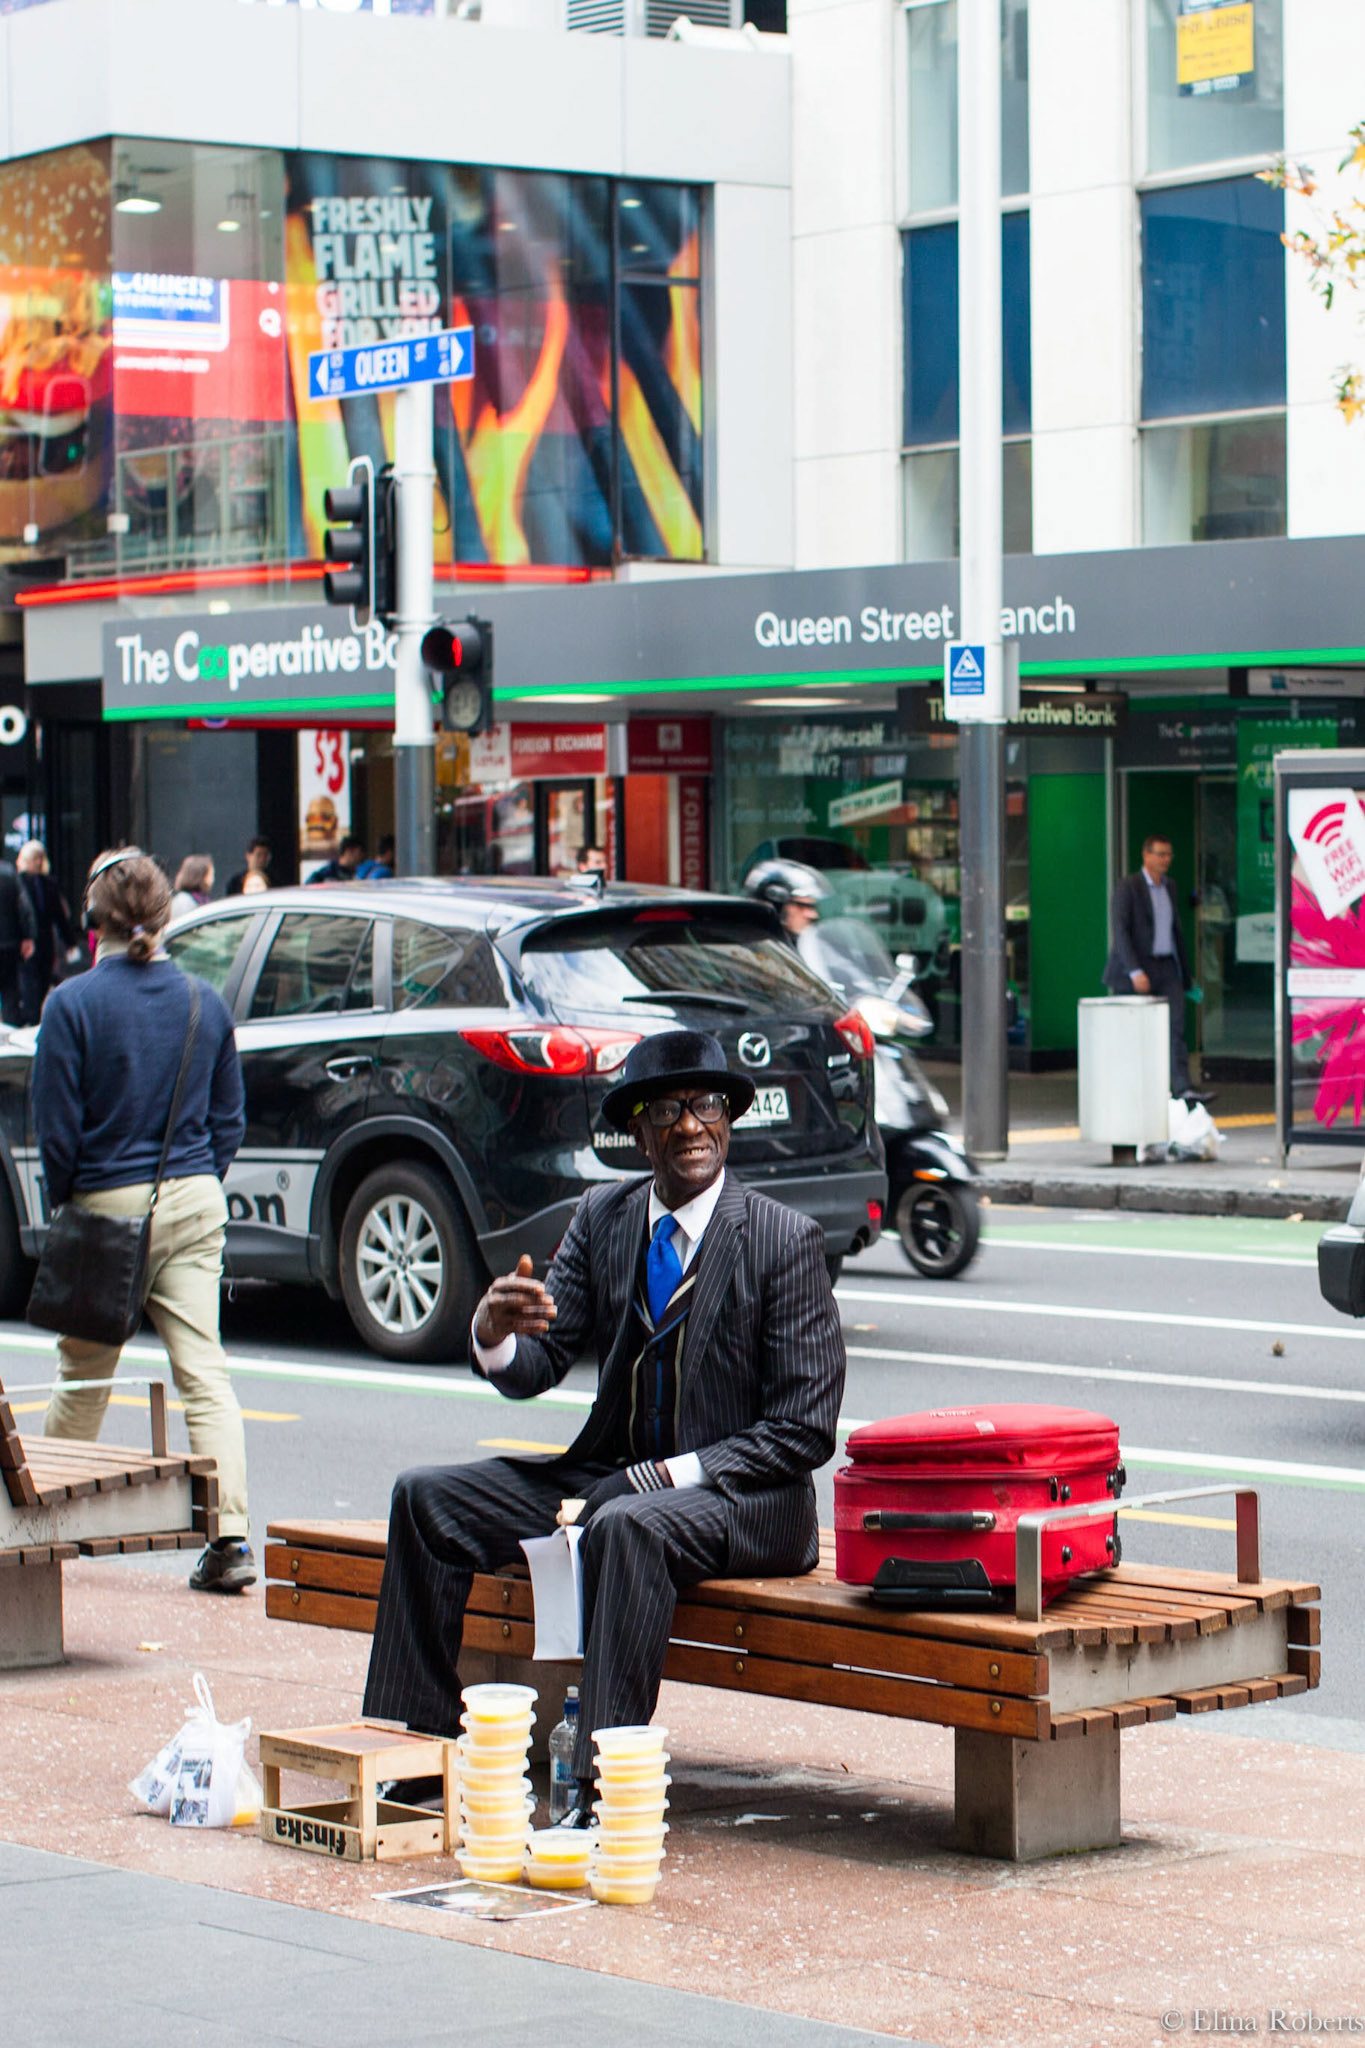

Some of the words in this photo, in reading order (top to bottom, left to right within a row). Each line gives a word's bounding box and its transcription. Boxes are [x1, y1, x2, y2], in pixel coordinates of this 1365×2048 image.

[311, 197, 433, 232] FRESHLY
[313, 234, 437, 279] FLAME
[316, 279, 441, 317] GRILLED
[355, 344, 410, 387] QUEEN
[755, 611, 852, 648] Queen
[860, 604, 954, 643] Street
[1001, 595, 1076, 636] anch
[115, 633, 170, 685] The
[173, 624, 362, 691] Cooperative
[1074, 701, 1117, 727] Bank
[316, 730, 345, 794] $3
[512, 737, 550, 753] FOREIGN
[553, 733, 604, 752] EXCHANGE
[1324, 838, 1354, 868] FREE
[751, 1092, 785, 1116] 442
[593, 1131, 637, 1149] Heine
[275, 1815, 347, 1857] finska
